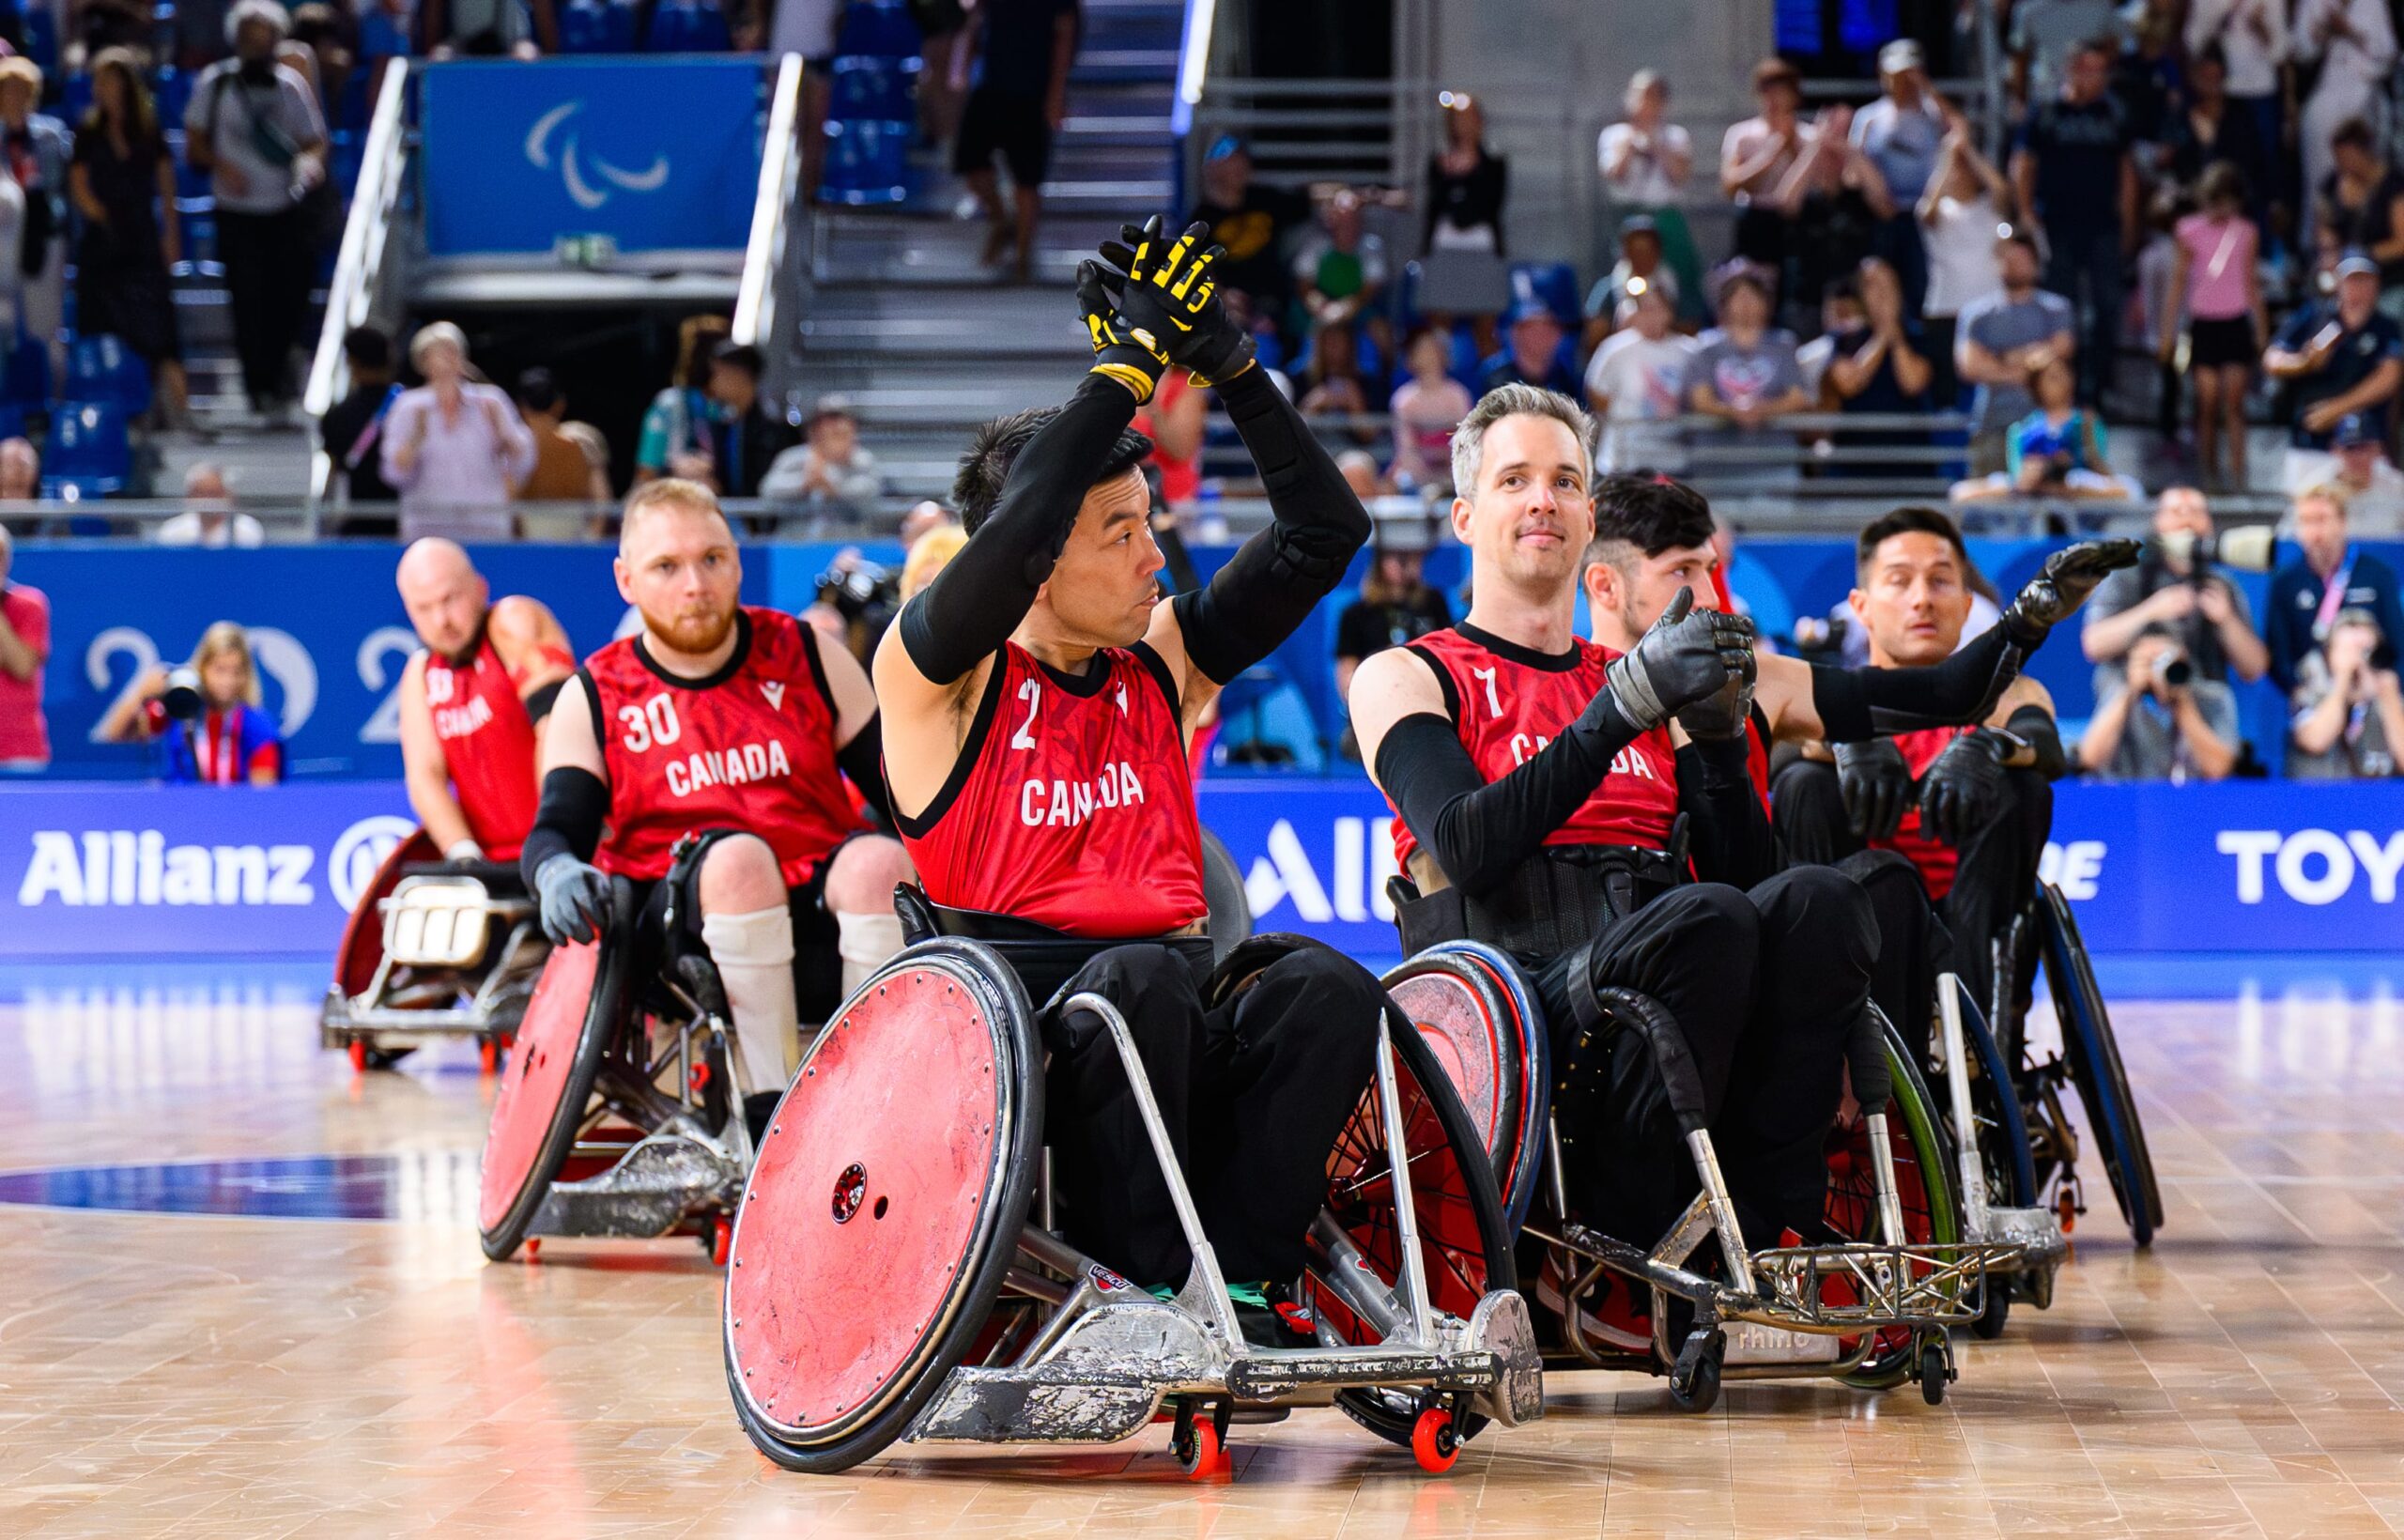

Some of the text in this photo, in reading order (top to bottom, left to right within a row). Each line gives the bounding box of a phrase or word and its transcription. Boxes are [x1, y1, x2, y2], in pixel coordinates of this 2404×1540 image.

[618, 692, 682, 754] 30
[1011, 677, 1040, 750] 2
[665, 739, 791, 798] CANADA
[1510, 732, 1654, 780] CDA
[1021, 762, 1145, 827] CANDA
[18, 829, 316, 907] Allianz
[2216, 828, 2404, 906] TOY
